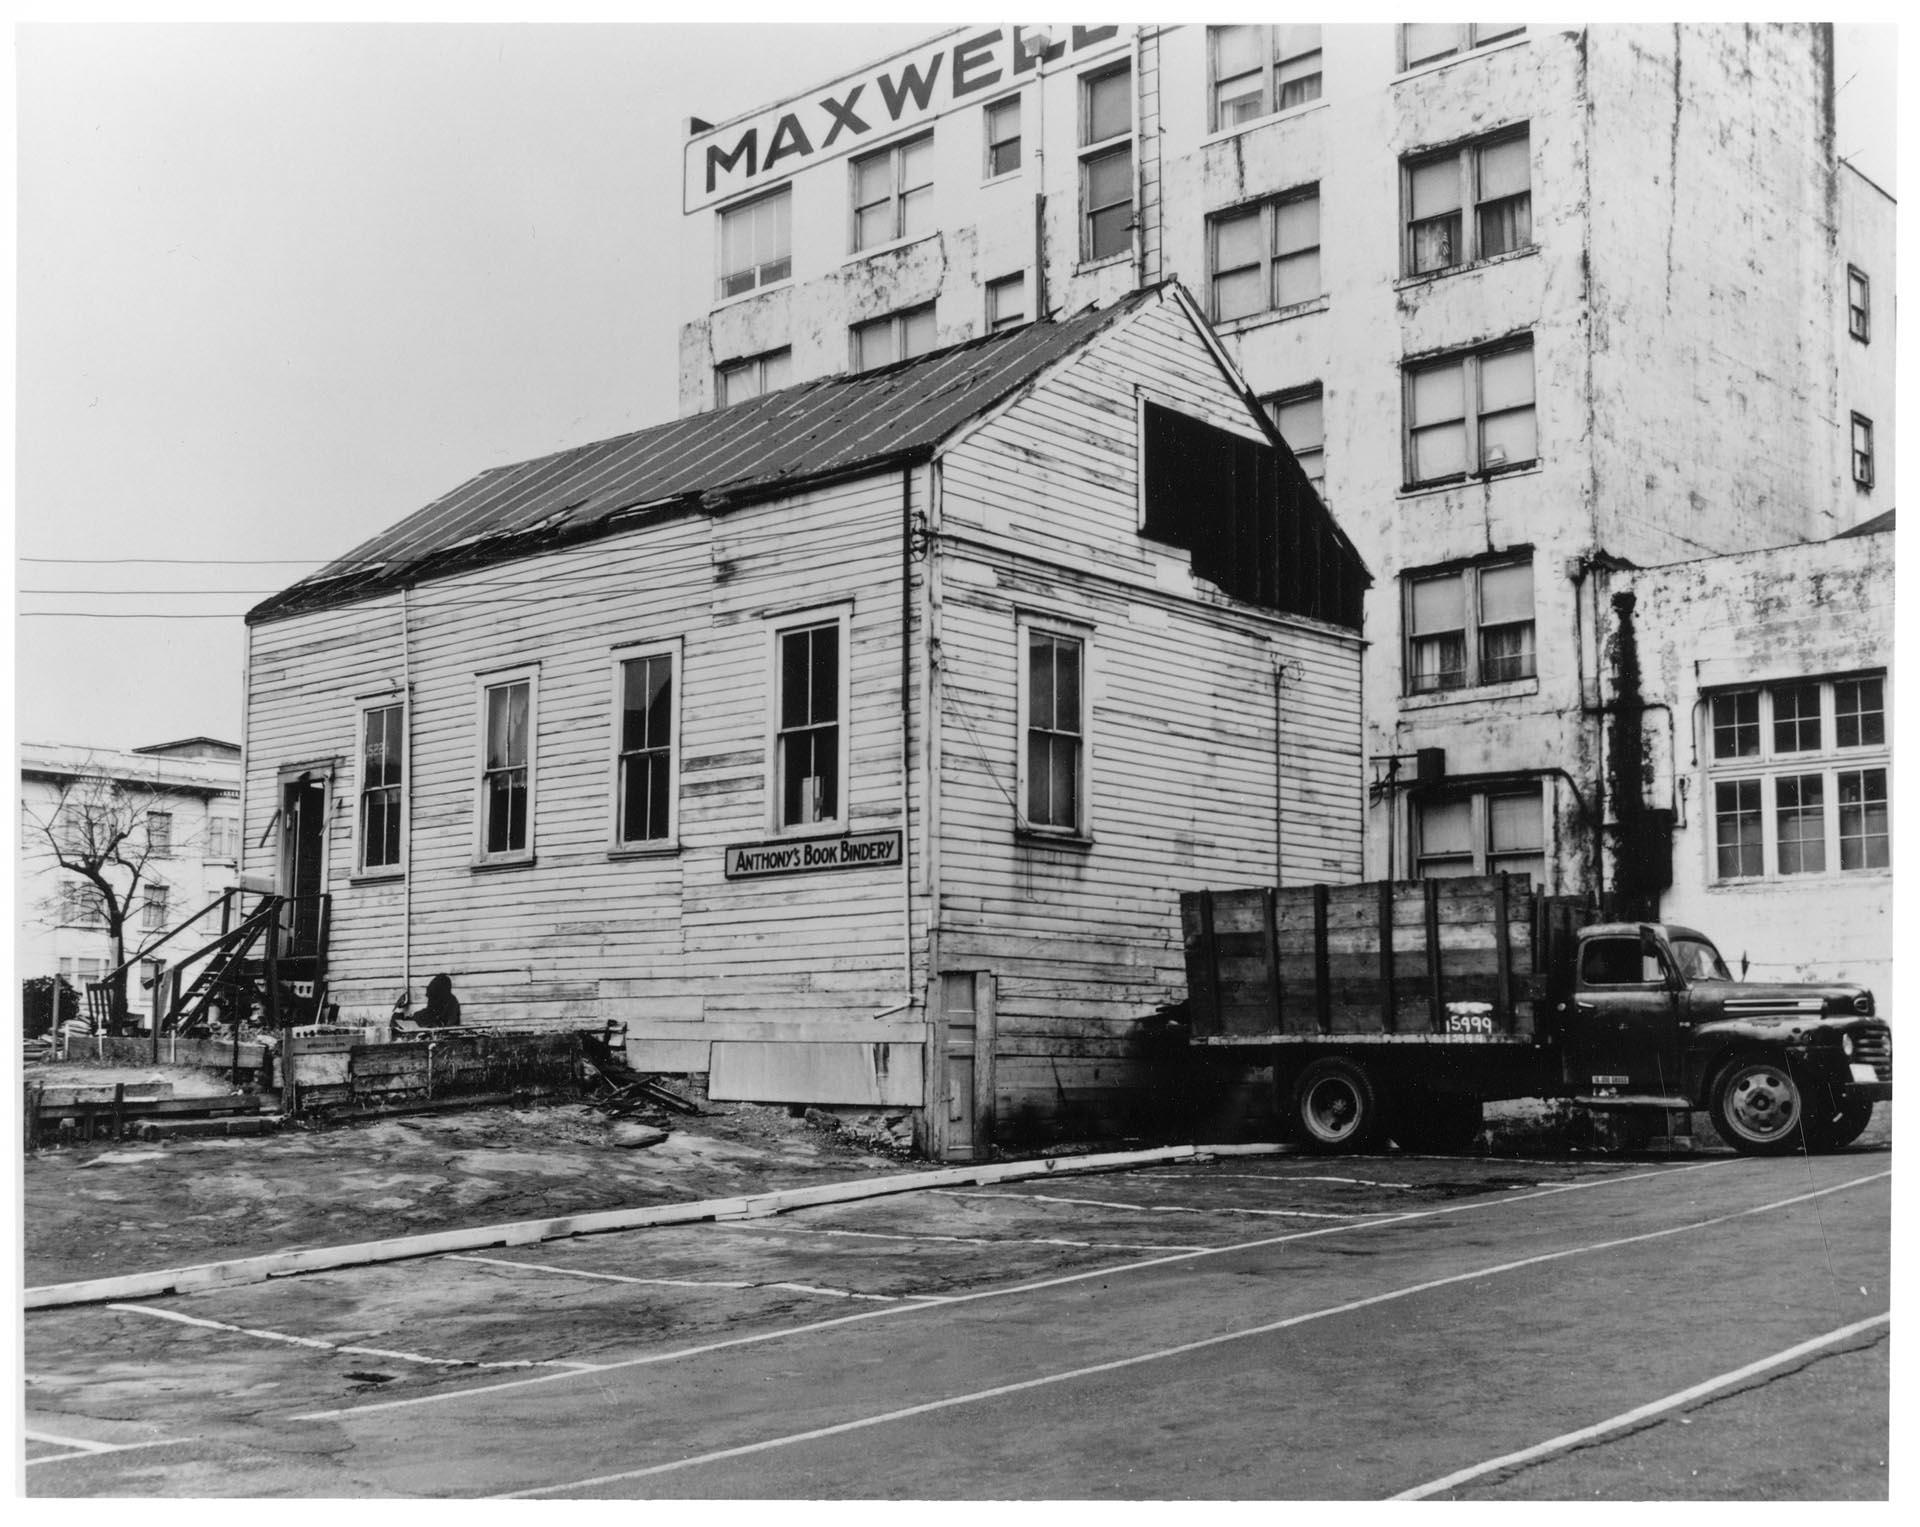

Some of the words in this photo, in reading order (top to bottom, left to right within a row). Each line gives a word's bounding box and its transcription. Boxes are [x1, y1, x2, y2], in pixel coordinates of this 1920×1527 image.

[735, 848, 801, 872] ANTHONY'S
[804, 844, 838, 866] BOOK
[840, 840, 895, 862] BINDERY
